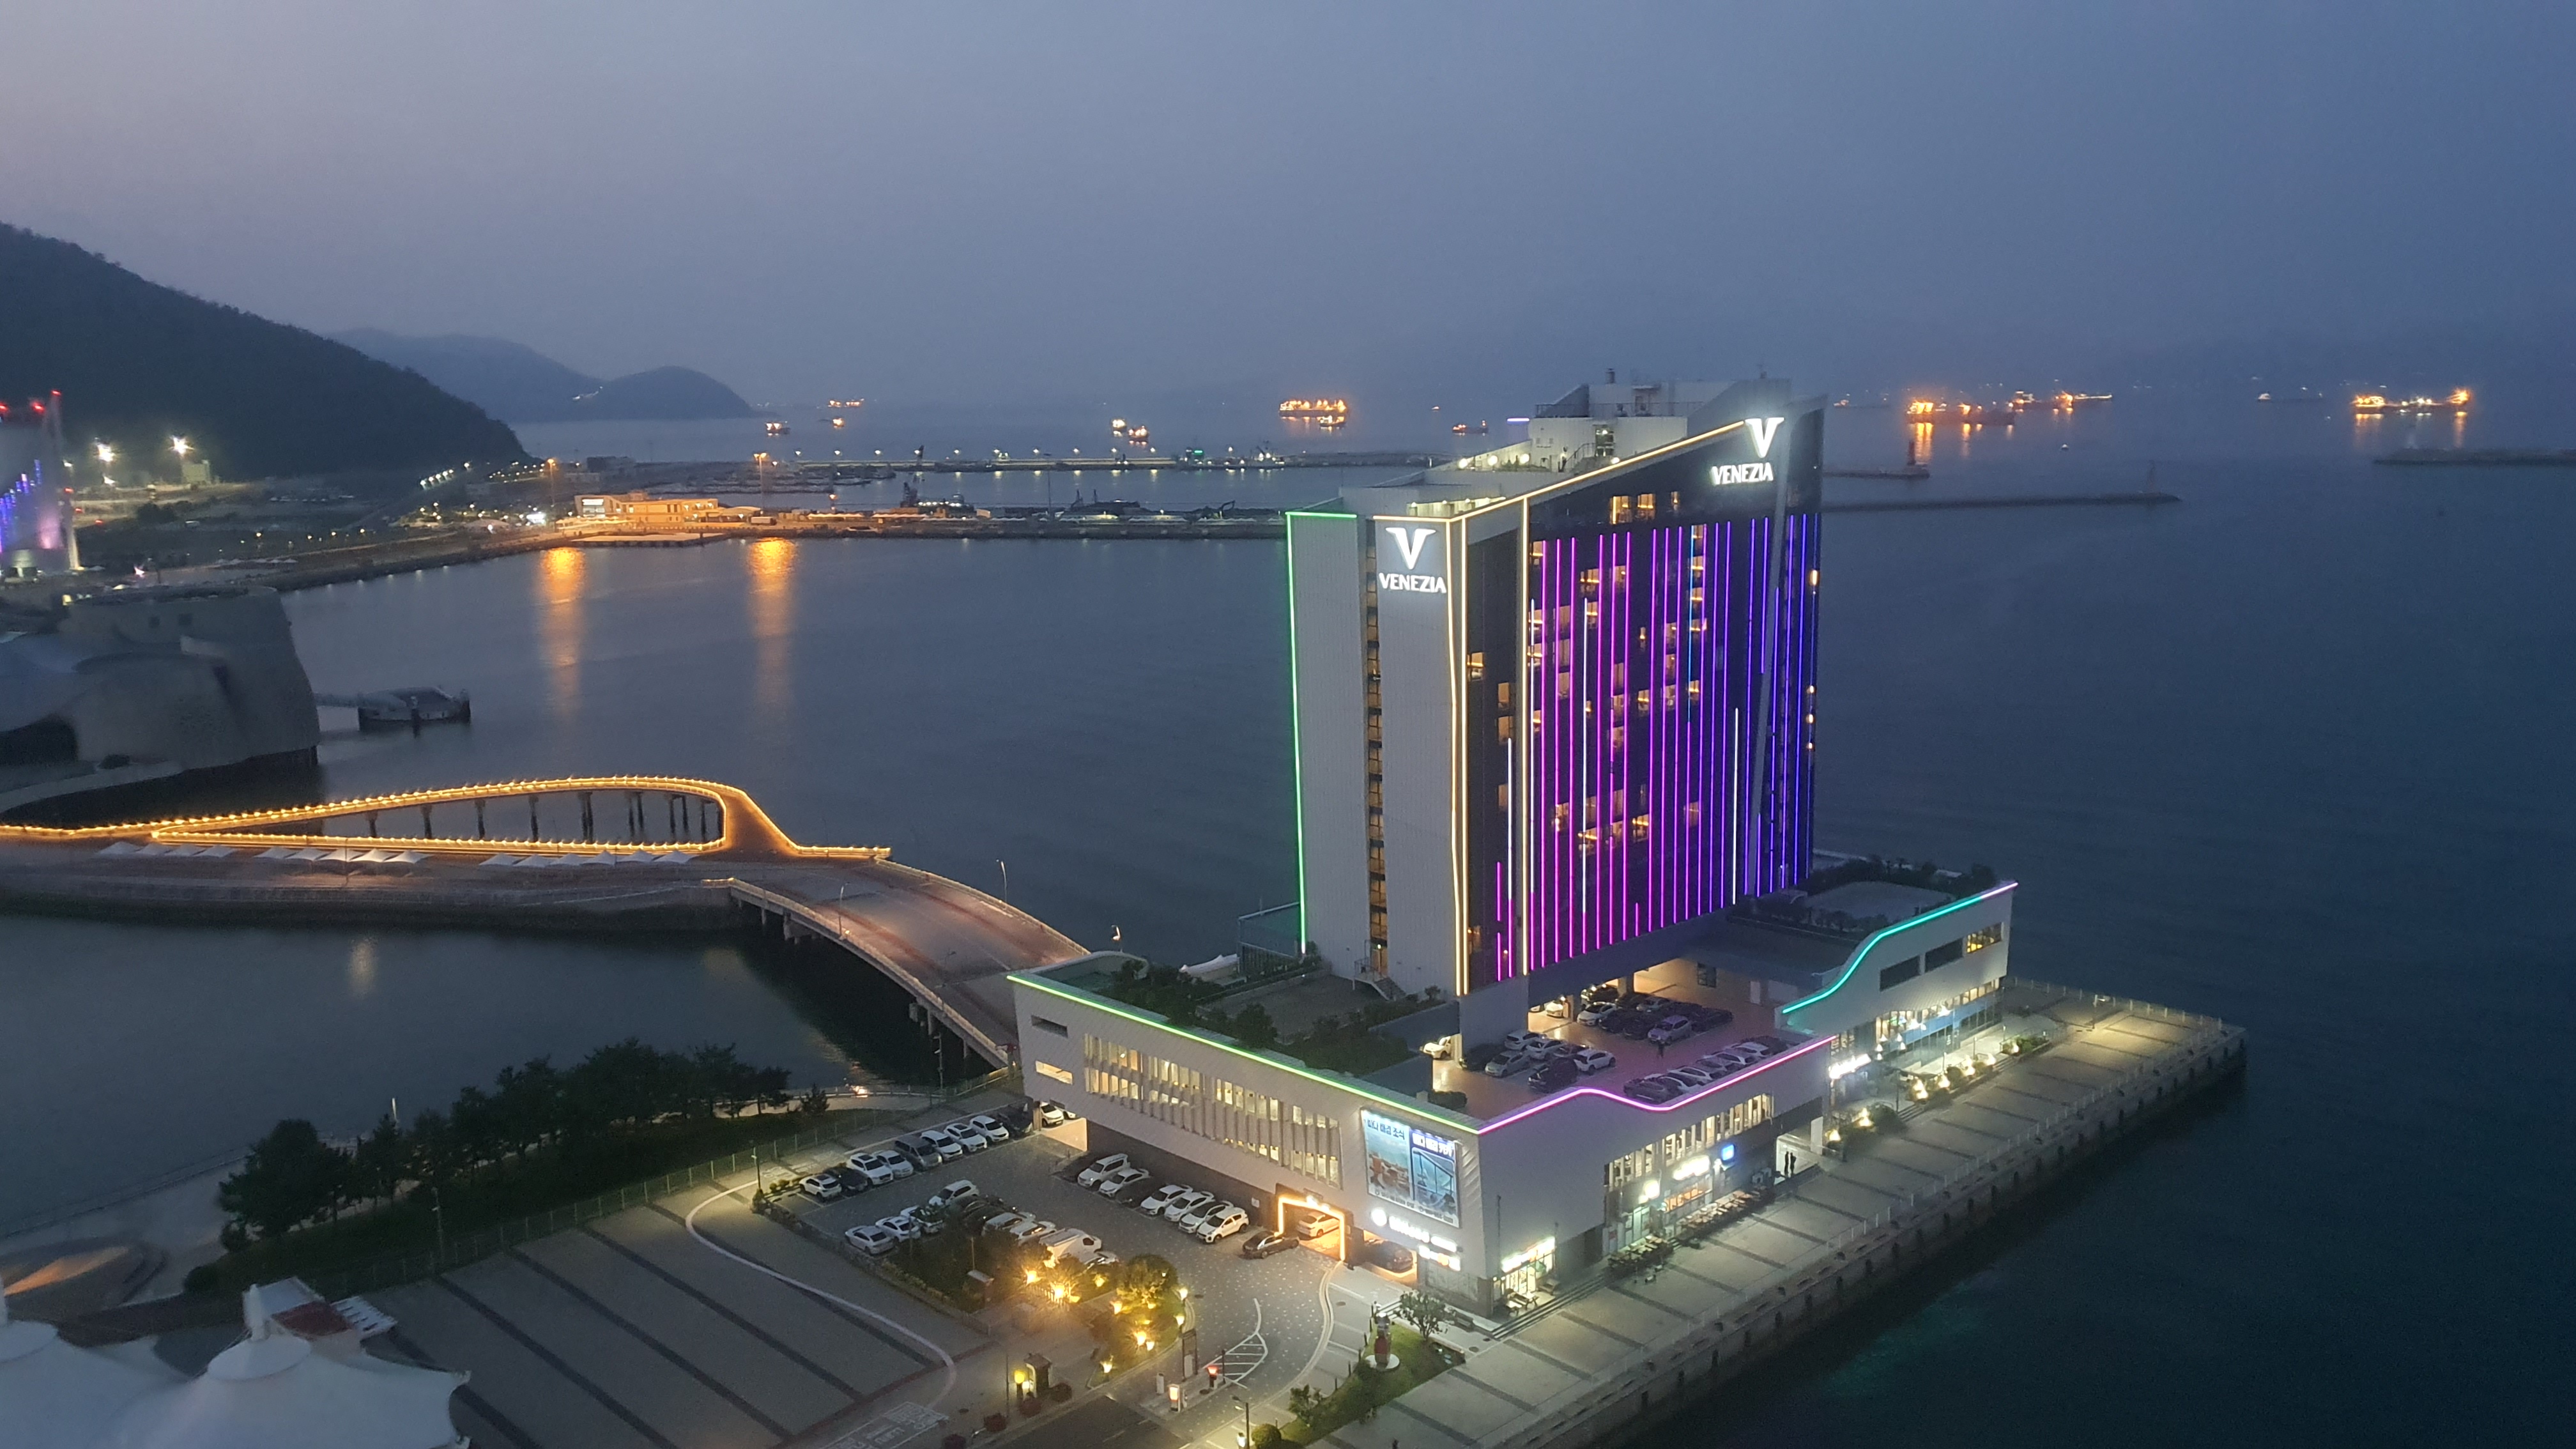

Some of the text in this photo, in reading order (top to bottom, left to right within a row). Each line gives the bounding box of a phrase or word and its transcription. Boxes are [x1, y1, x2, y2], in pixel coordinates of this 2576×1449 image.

[1745, 417, 1784, 458] V
[1711, 462, 1774, 486] VENEZIA
[1385, 527, 1436, 570] V
[1379, 572, 1446, 594] VENEZIA
[1393, 1126, 1405, 1140] 조식
